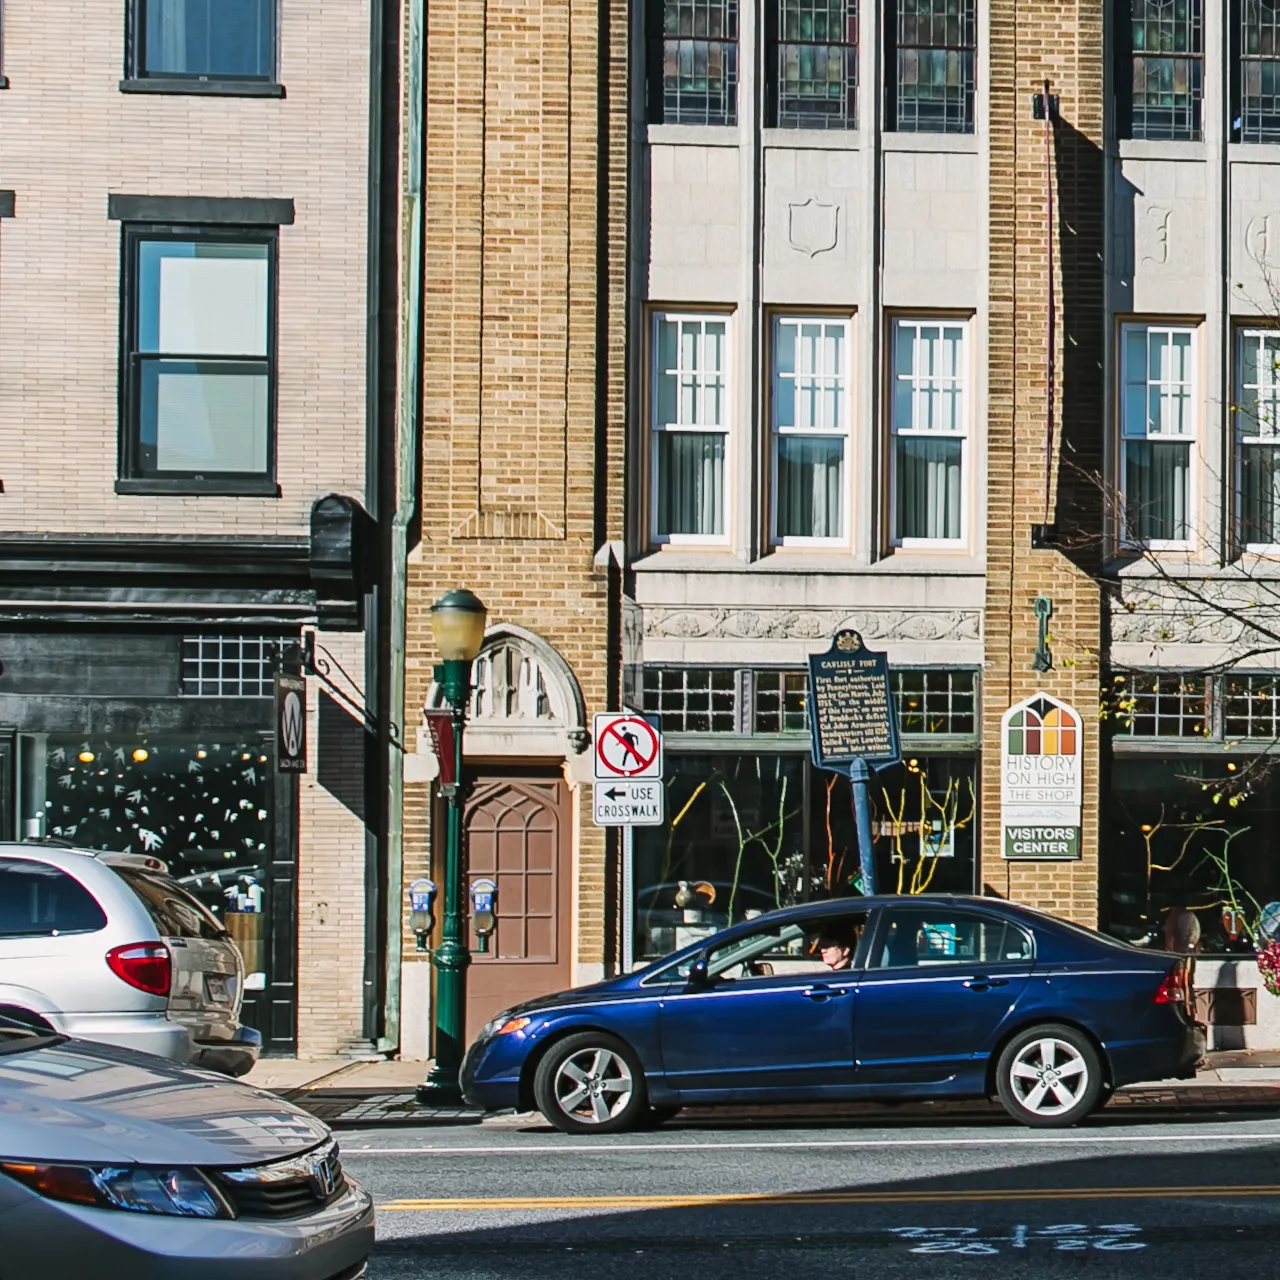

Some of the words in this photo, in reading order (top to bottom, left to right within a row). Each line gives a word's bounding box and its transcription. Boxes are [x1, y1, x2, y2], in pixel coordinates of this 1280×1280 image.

[1007, 755, 1075, 770] HISTORY
[1007, 772, 1031, 785] ON
[1038, 772, 1076, 785] HIGH
[631, 787, 654, 800] USE
[1010, 790, 1031, 800] THE
[1037, 790, 1073, 800] SHOP
[598, 804, 658, 817] CROSSWALK
[1007, 827, 1075, 840] VISITORS
[1013, 841, 1069, 853] CENTER
